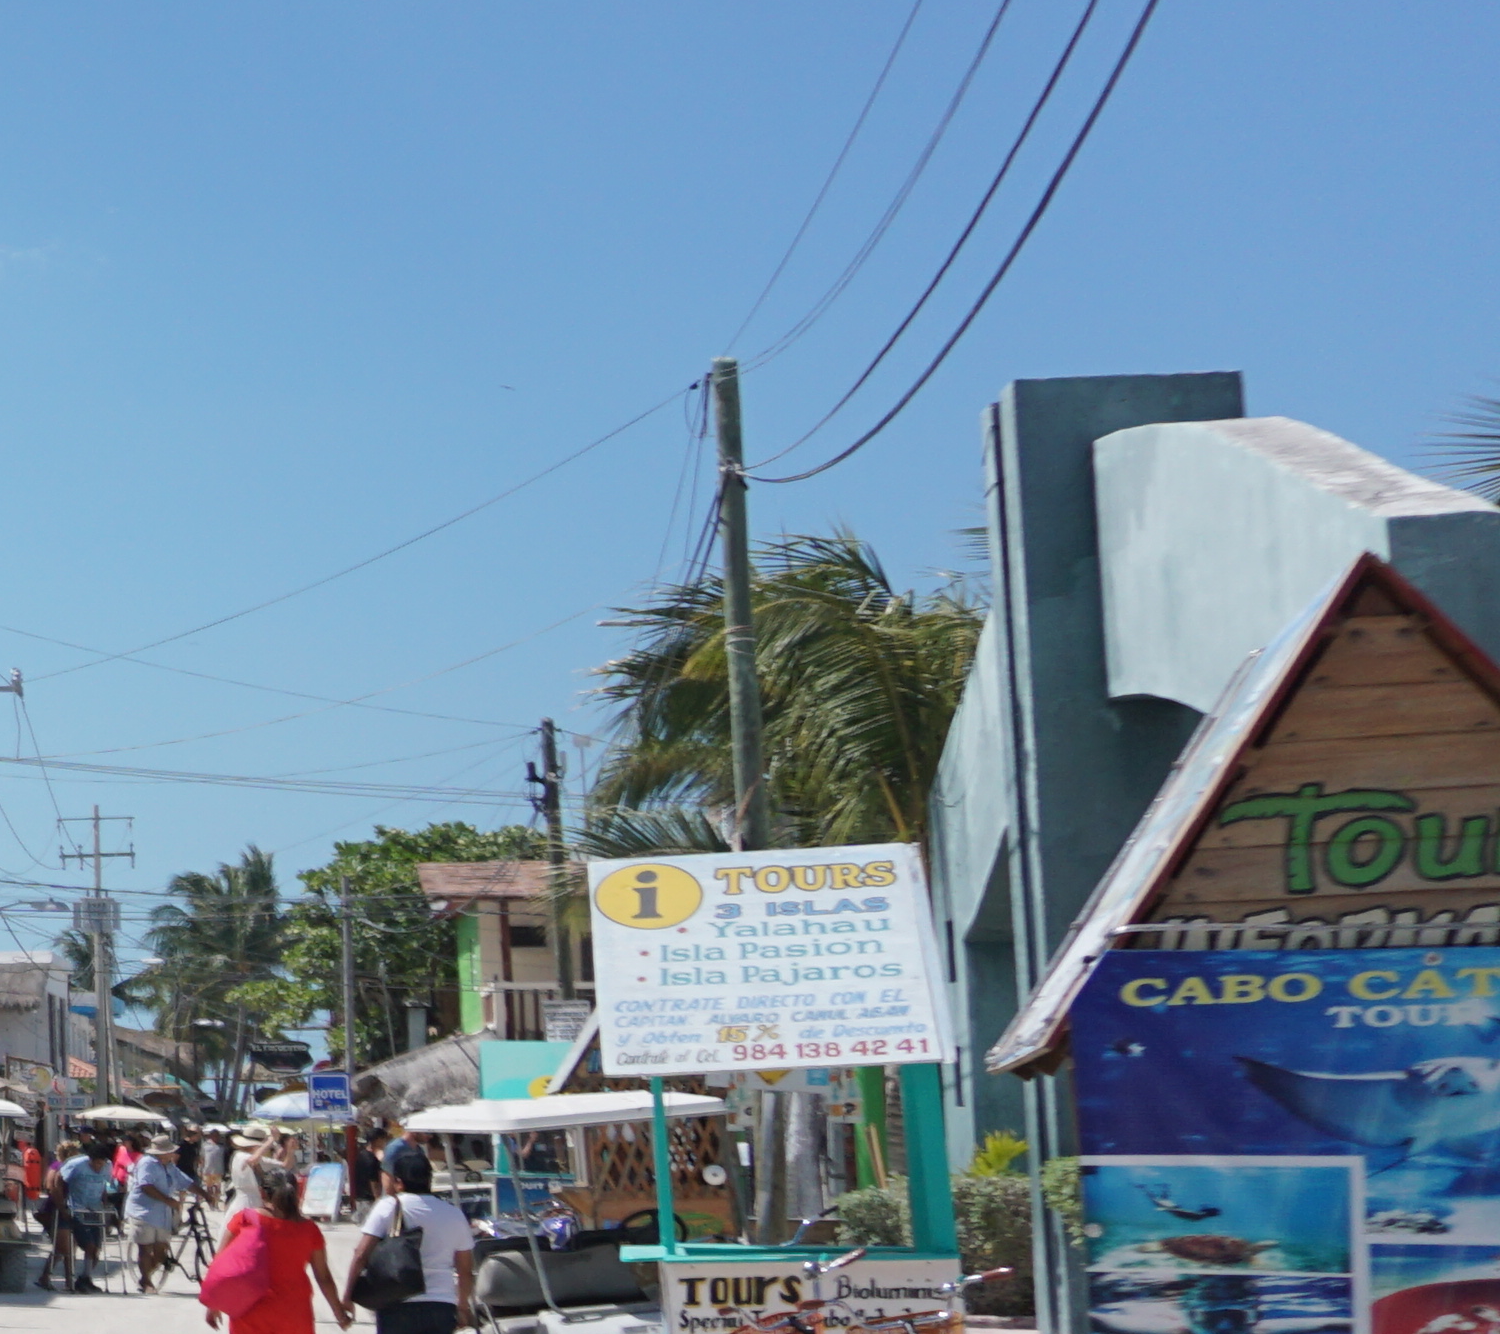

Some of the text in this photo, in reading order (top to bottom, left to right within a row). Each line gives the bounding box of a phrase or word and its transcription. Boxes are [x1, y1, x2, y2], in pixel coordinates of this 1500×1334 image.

[1220, 782, 1500, 896] Tou
[715, 860, 898, 896] TOURS
[715, 896, 891, 919] 3 ISLAS
[705, 917, 891, 939] Yalahau
[659, 944, 725, 963] Isla
[659, 961, 903, 987] Isla Pajaros
[614, 988, 909, 1014] CONTRATE DIRECTO CON EL
[1120, 973, 1324, 1008] CABO
[832, 1020, 928, 1039] Descuento
[732, 1043, 787, 1062] 984
[795, 1041, 842, 1059] 138
[851, 1039, 889, 1057] 42
[895, 1037, 931, 1055] 41
[312, 1089, 349, 1100] HOTEL
